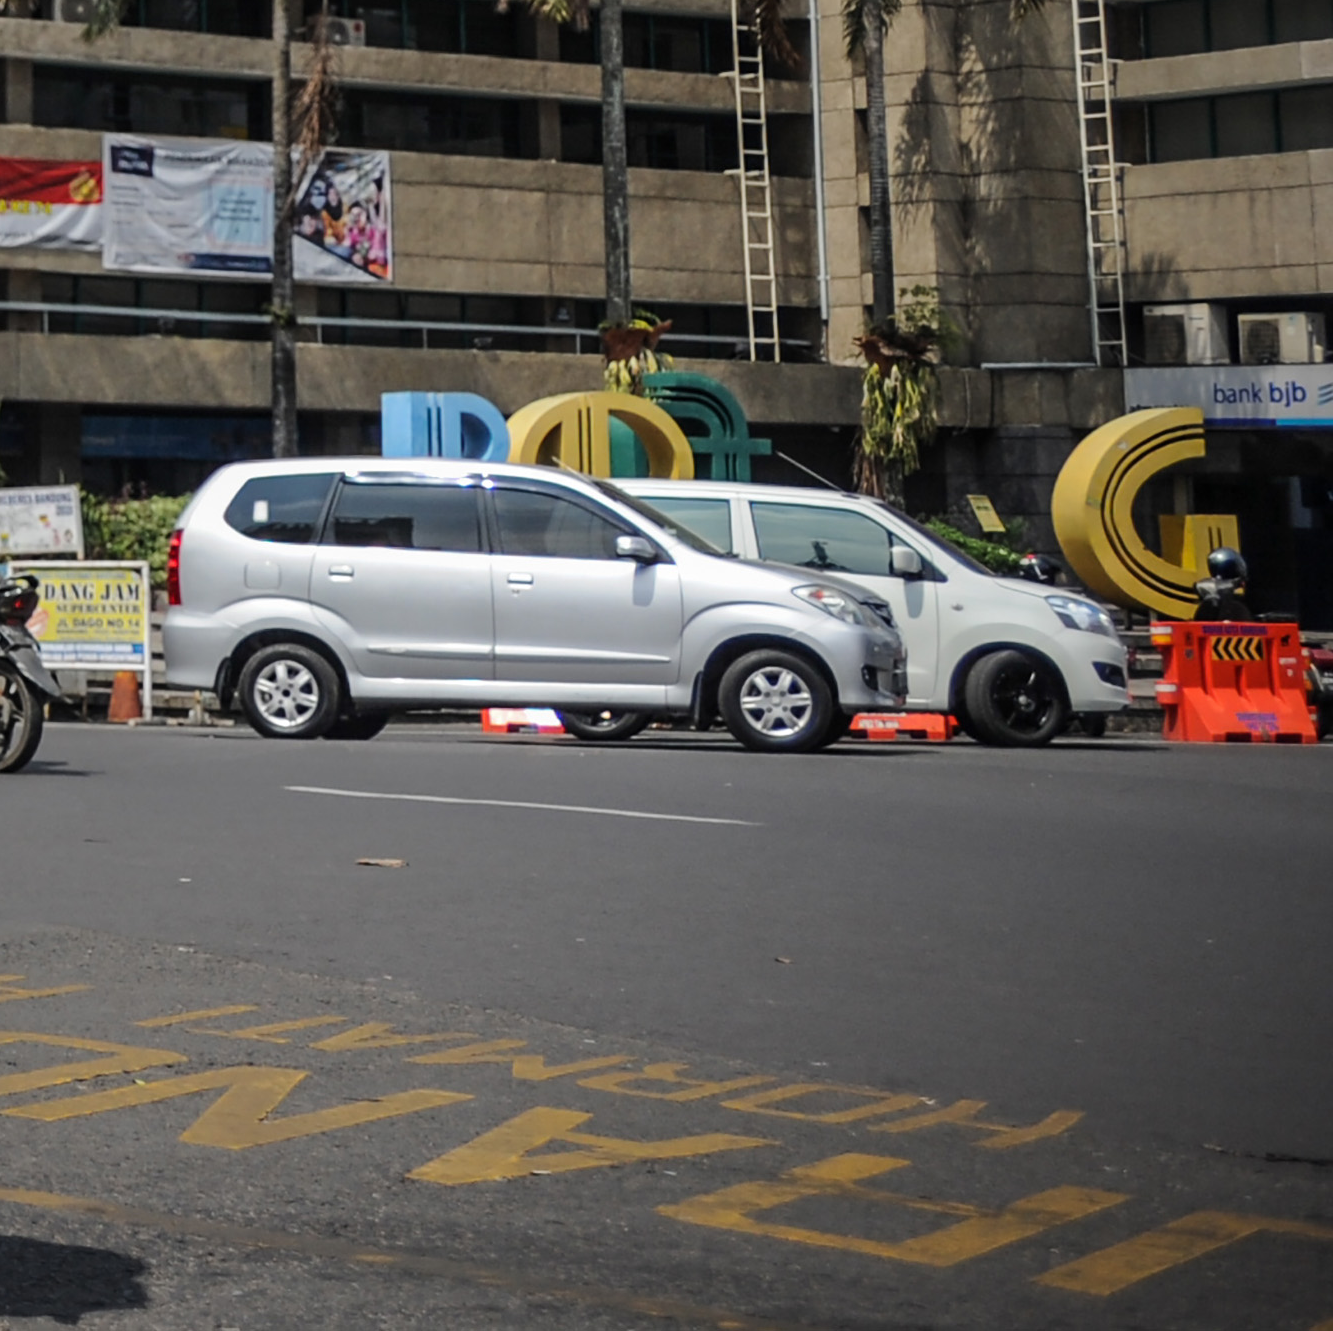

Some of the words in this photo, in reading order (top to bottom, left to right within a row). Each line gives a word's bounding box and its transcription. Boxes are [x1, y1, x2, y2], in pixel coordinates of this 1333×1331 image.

[1213, 383, 1263, 404] bank
[1269, 381, 1308, 408] bjb
[100, 583, 140, 601] JAM
[56, 604, 141, 614] SUPERCENTER
[73, 618, 104, 628] DAGO
[131, 1004, 1088, 1149] HORMATI
